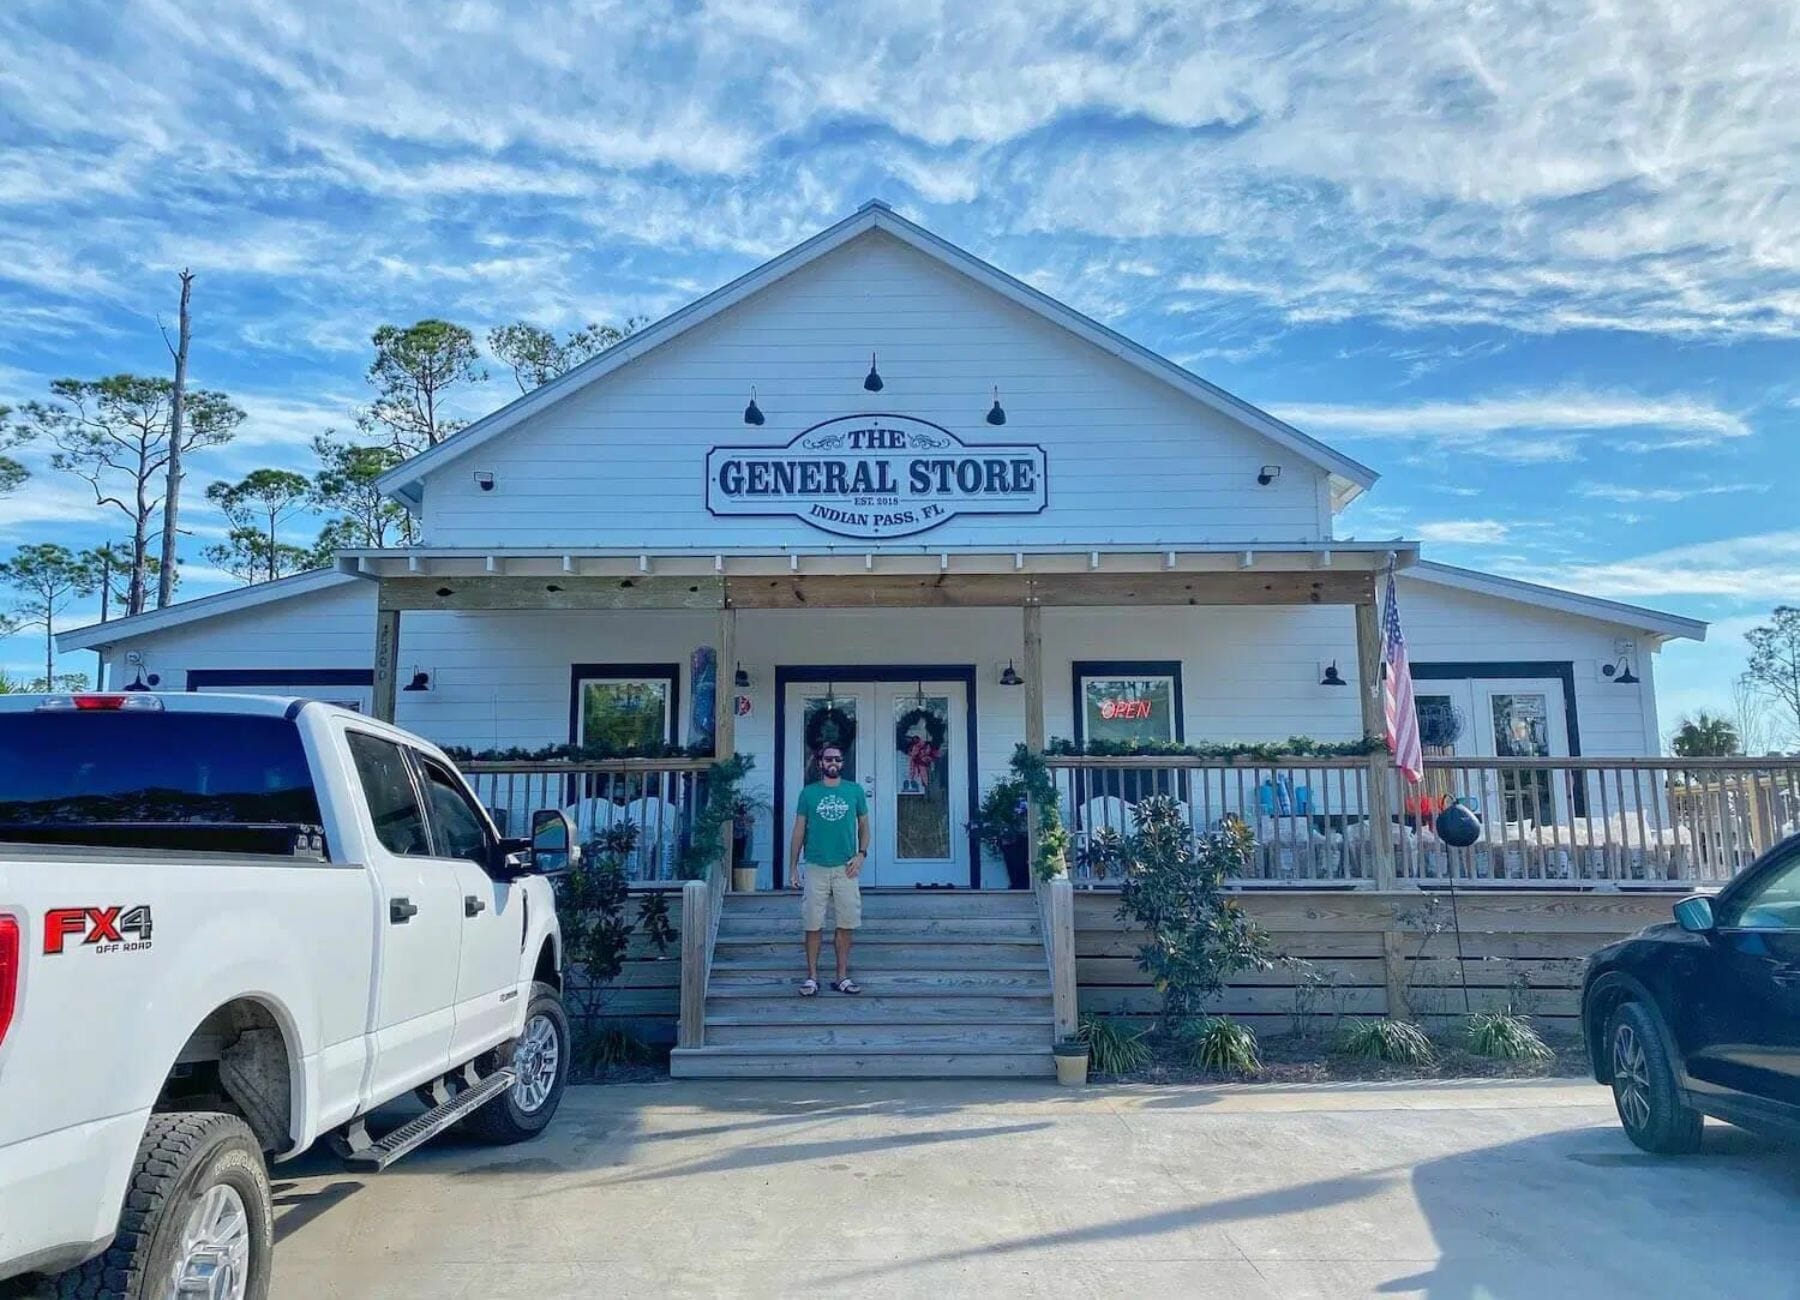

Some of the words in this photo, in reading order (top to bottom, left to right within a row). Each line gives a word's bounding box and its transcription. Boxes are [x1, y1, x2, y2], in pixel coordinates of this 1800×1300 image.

[847, 429, 906, 450] THE
[718, 459, 898, 496] GENERAL
[909, 458, 1036, 495] STORE
[854, 496, 875, 506] EST.
[809, 504, 868, 526] INDIAN
[872, 510, 920, 527] PASS,
[922, 503, 946, 519] FL
[1102, 701, 1151, 719] OPEN
[43, 905, 152, 955] FX4
[96, 945, 119, 954] OFF
[123, 942, 152, 953] ROAD
